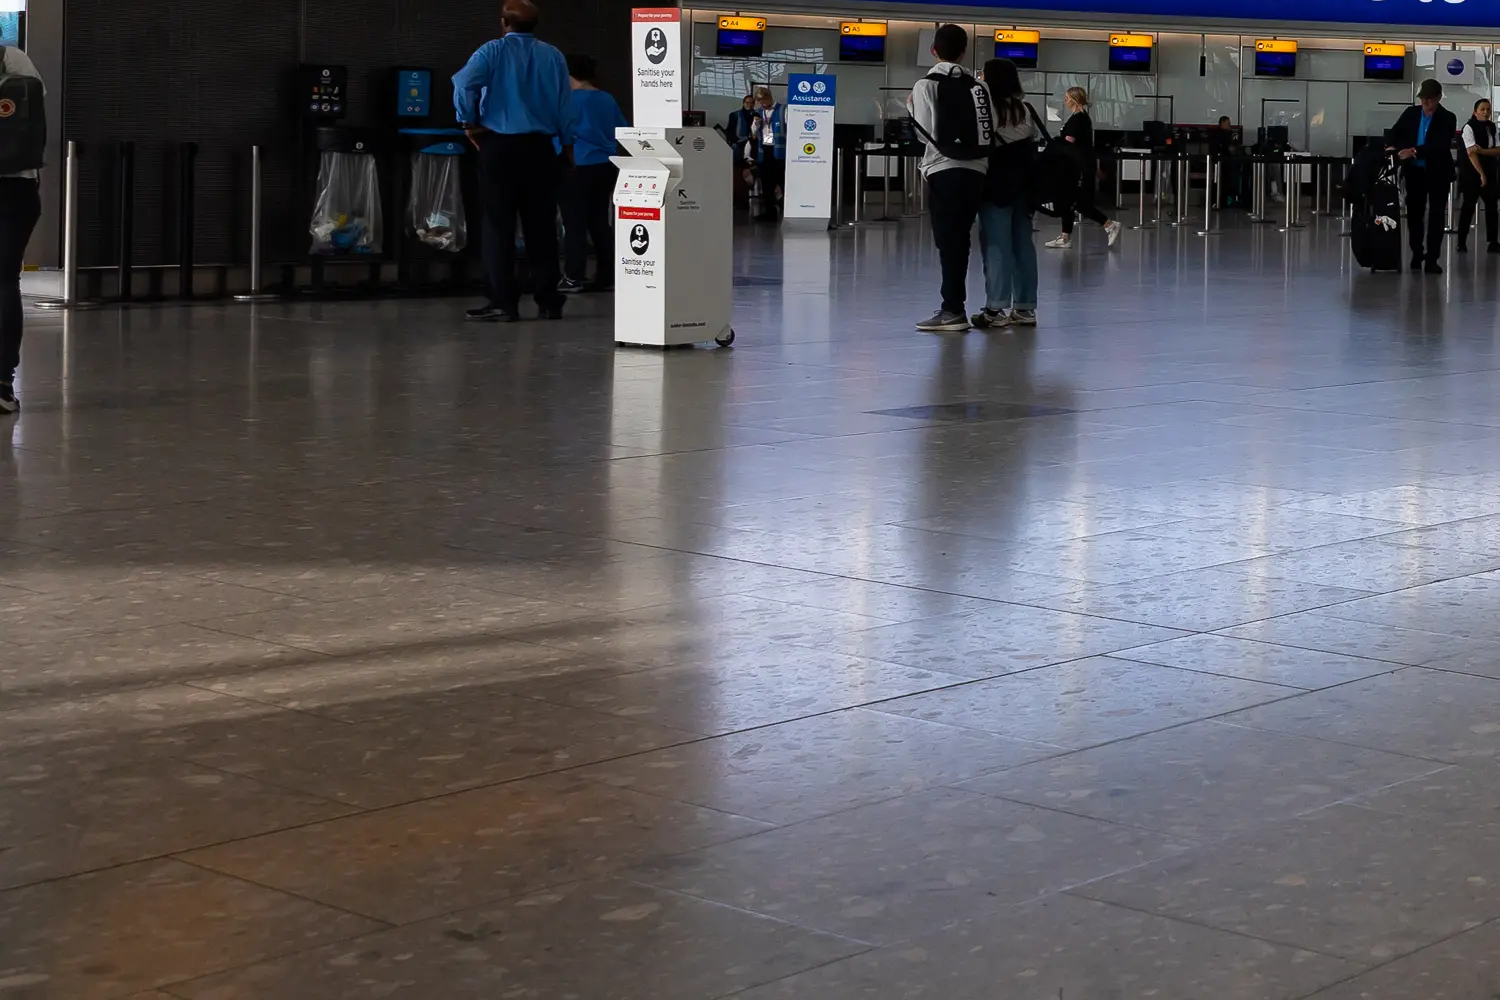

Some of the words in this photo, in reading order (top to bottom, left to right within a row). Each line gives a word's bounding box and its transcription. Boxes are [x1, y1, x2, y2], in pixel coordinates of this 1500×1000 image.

[637, 68, 660, 77] Sanitise
[660, 69, 675, 78] your
[640, 79, 659, 88] hands
[660, 79, 673, 88] here
[792, 94, 831, 102] Assistance
[974, 88, 991, 140] adidas
[622, 257, 642, 266] Sanitise
[643, 259, 655, 268] your
[625, 267, 641, 275] hands
[641, 268, 654, 276] here
